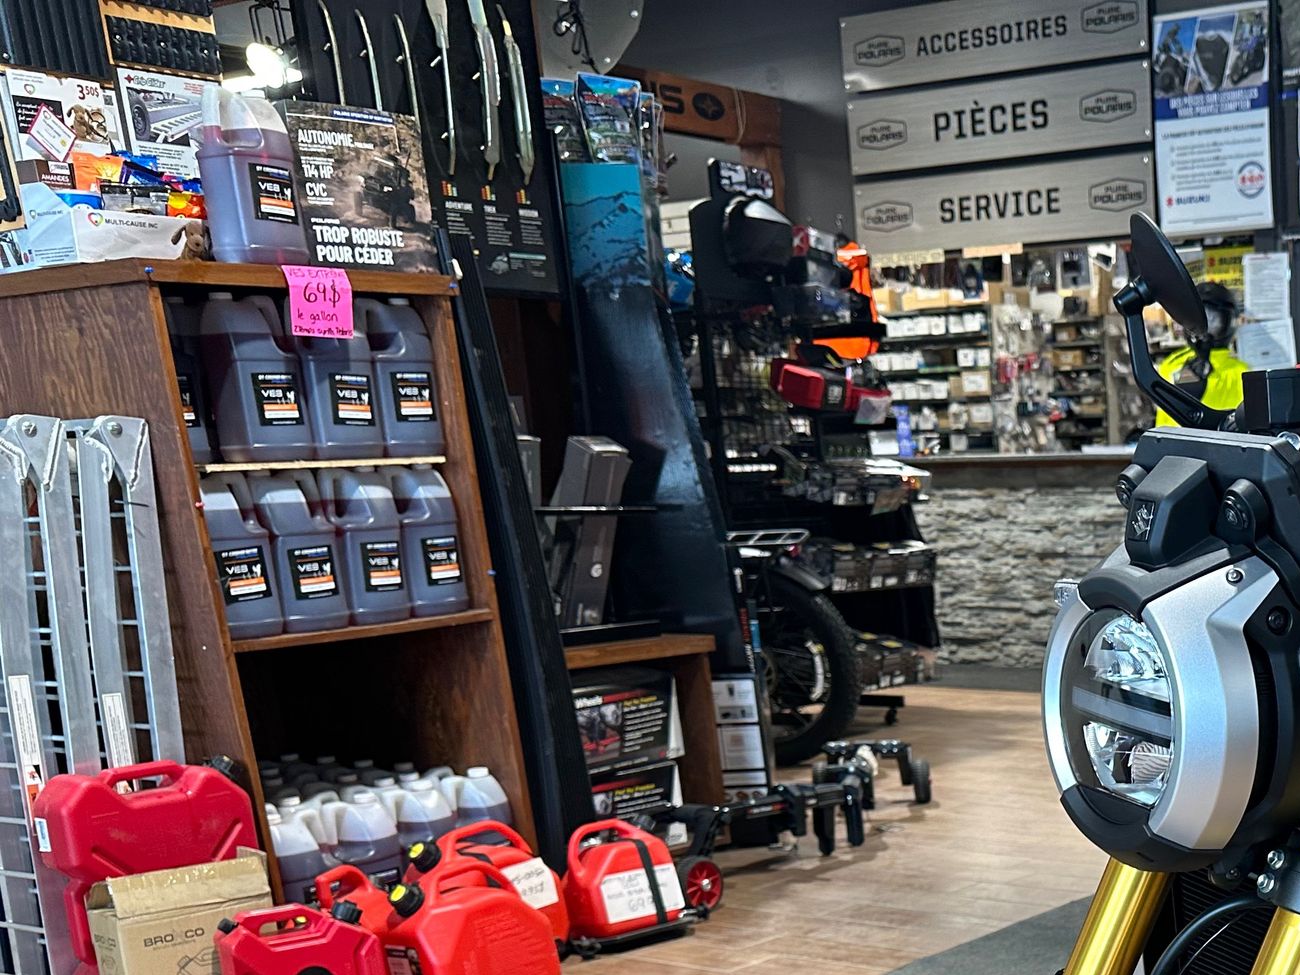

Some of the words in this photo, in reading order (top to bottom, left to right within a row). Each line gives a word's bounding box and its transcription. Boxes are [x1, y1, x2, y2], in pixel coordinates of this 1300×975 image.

[1085, 12, 1136, 27] POLARIS
[916, 15, 1068, 57] ACCESSOIRES
[857, 48, 901, 60] POLARIS
[1084, 102, 1133, 115] POLARIS
[934, 99, 1050, 142] PIÈCES
[861, 131, 904, 144] POLARIS
[319, 165, 334, 179] HP
[306, 183, 328, 197] CVC
[1094, 191, 1142, 205] POLARIS
[940, 188, 1061, 224] SERVICE
[104, 217, 147, 229] MULTI-CAUSE
[866, 213, 910, 226] POLARIS
[312, 225, 349, 243] TROP
[351, 227, 405, 248] ROBUSTE
[316, 246, 352, 263] POUR
[297, 307, 304, 320] le
[309, 310, 339, 325] gallon
